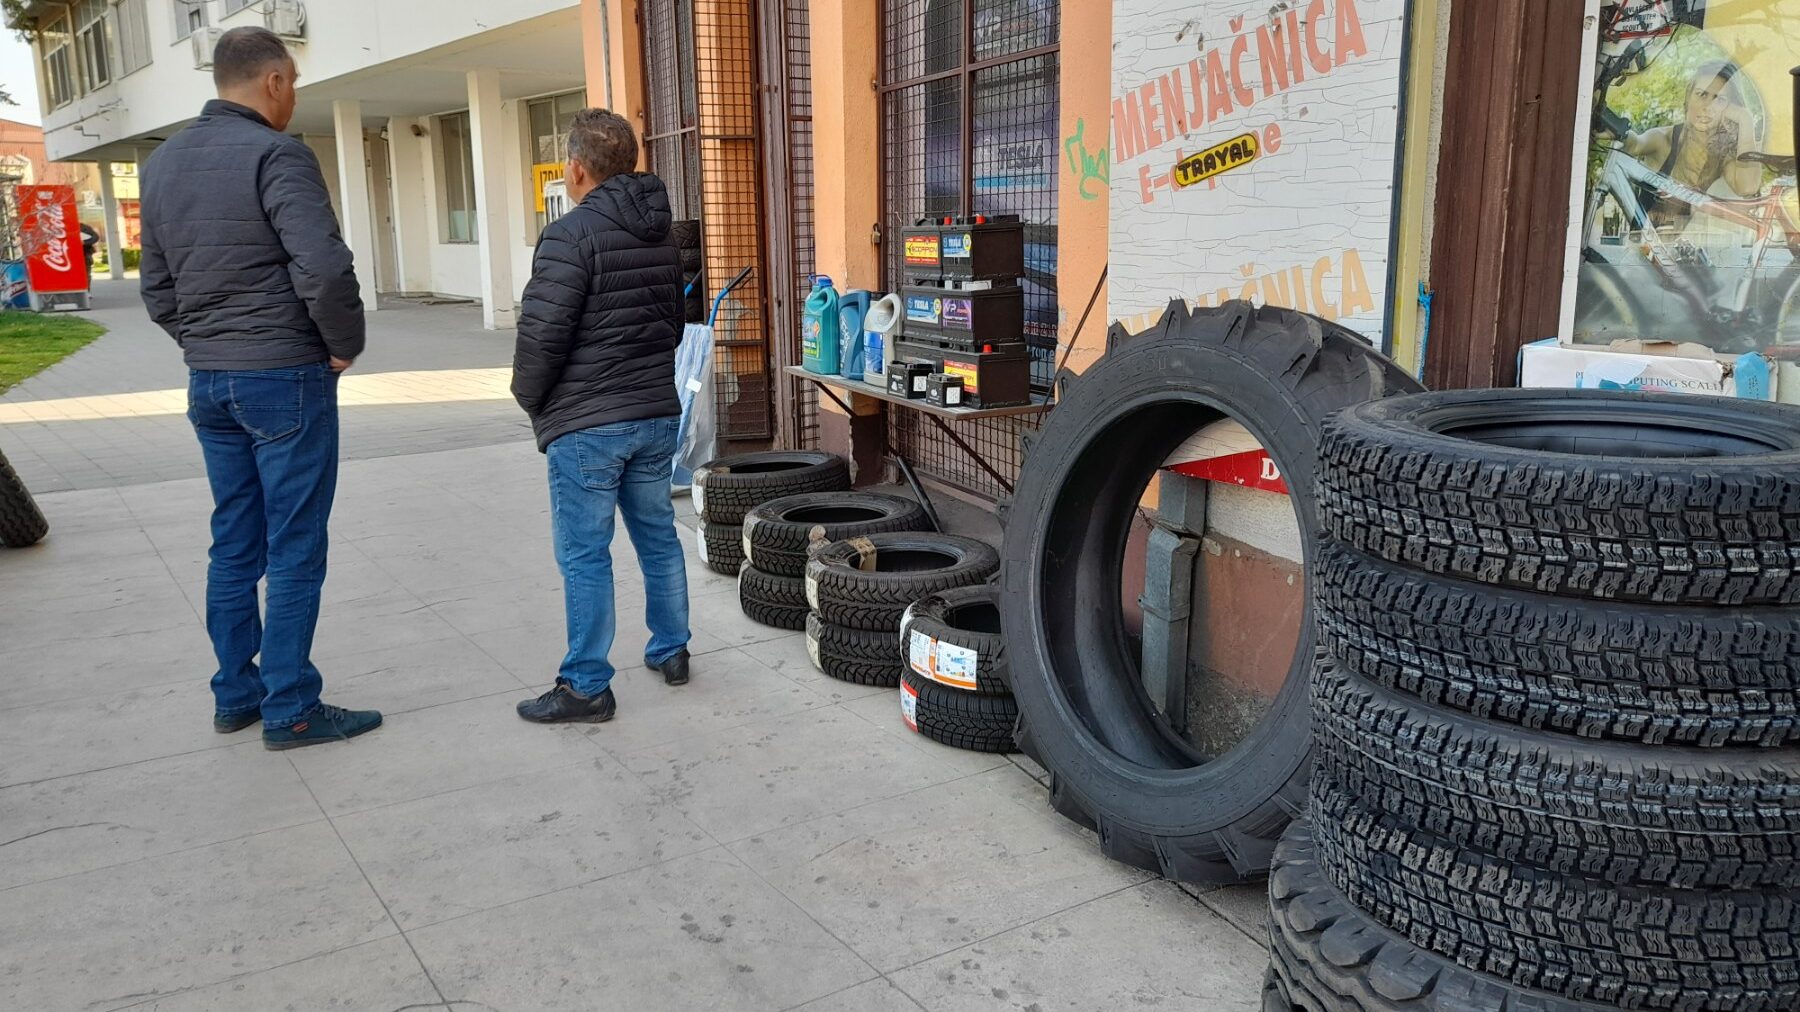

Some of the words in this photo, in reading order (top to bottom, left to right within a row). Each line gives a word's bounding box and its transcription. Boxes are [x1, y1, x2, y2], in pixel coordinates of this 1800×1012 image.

[1111, 0, 1368, 164] MENJAČNICA
[999, 143, 1044, 170] TESLA
[1177, 139, 1254, 181] TRAYAL
